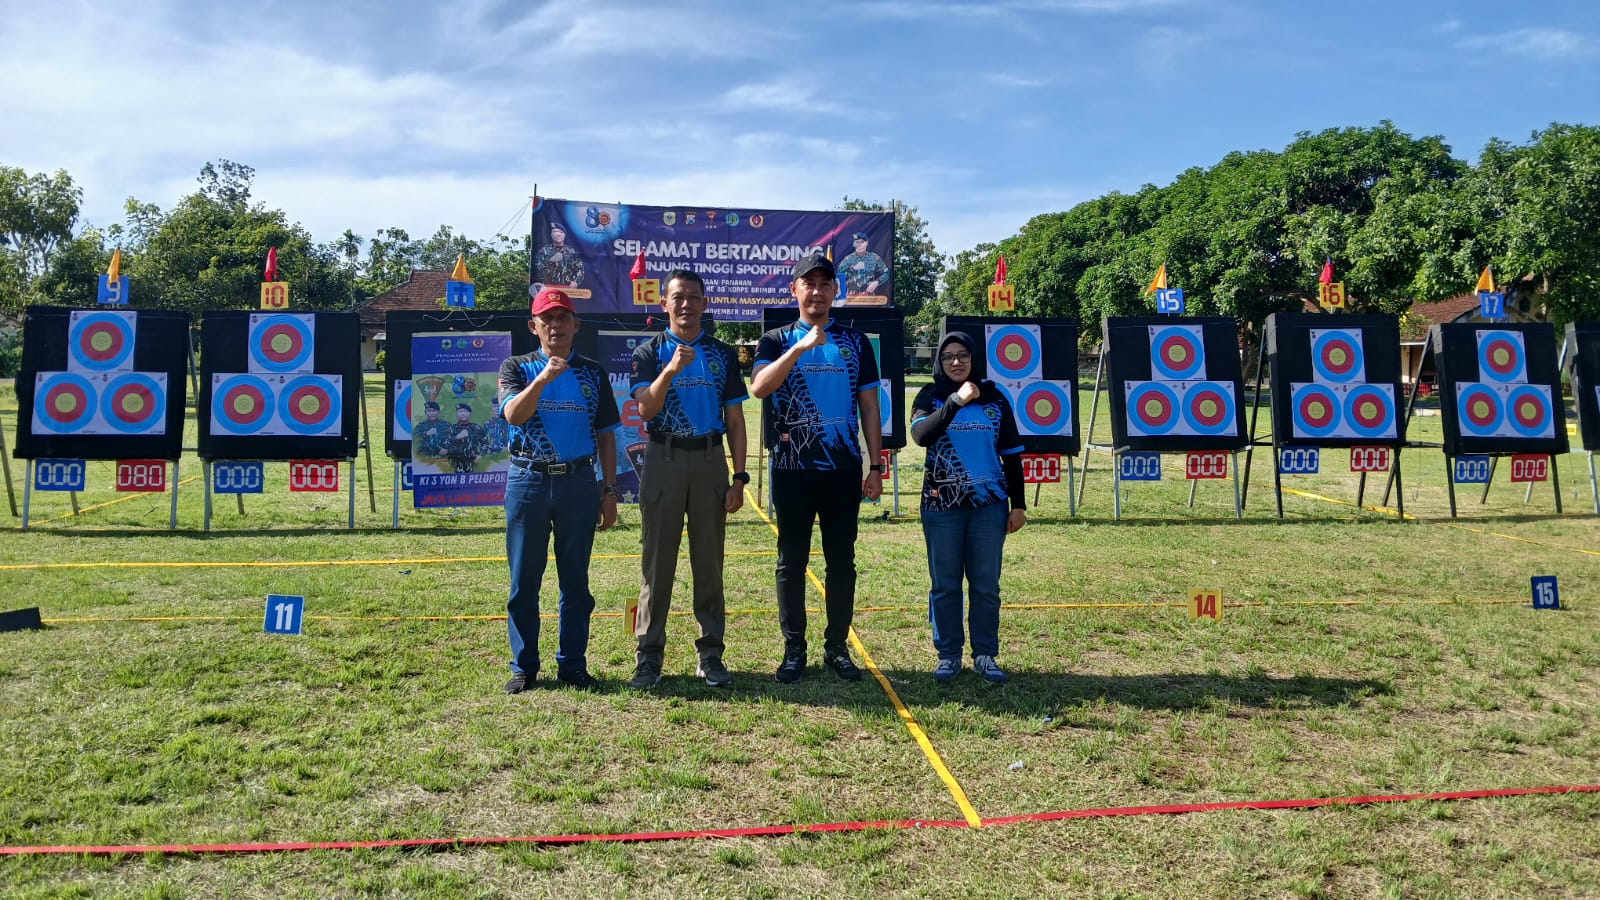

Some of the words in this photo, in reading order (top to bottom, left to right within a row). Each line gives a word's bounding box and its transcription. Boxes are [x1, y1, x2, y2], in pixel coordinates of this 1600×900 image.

[613, 239, 700, 259] SELAMAT
[706, 243, 824, 261] BERTANDING
[694, 262, 733, 274] TINGGI
[265, 284, 284, 307] 10
[711, 296, 738, 304] UNTUK
[740, 297, 789, 305] MASYARAKAT
[992, 290, 1012, 307] 14
[1160, 290, 1180, 310] 15
[1323, 284, 1340, 305] 16
[1485, 295, 1499, 314] 17
[1021, 457, 1059, 480] 000
[1121, 456, 1159, 476] 000
[1188, 454, 1226, 475] 000
[1282, 449, 1318, 471] 000
[1352, 448, 1389, 469] 000
[1513, 459, 1547, 478] 000
[38, 463, 81, 486] 000
[118, 464, 162, 487] 080
[216, 466, 260, 488] 000
[292, 464, 337, 488] 000
[420, 476, 429, 486] KI
[431, 476, 437, 485] 3
[440, 475, 457, 485] YON
[460, 475, 466, 484] B
[468, 473, 506, 484] PELOPOR
[1456, 460, 1488, 480] 000
[1536, 582, 1555, 605] 15
[275, 603, 294, 630] 11
[1194, 595, 1217, 619] 14
